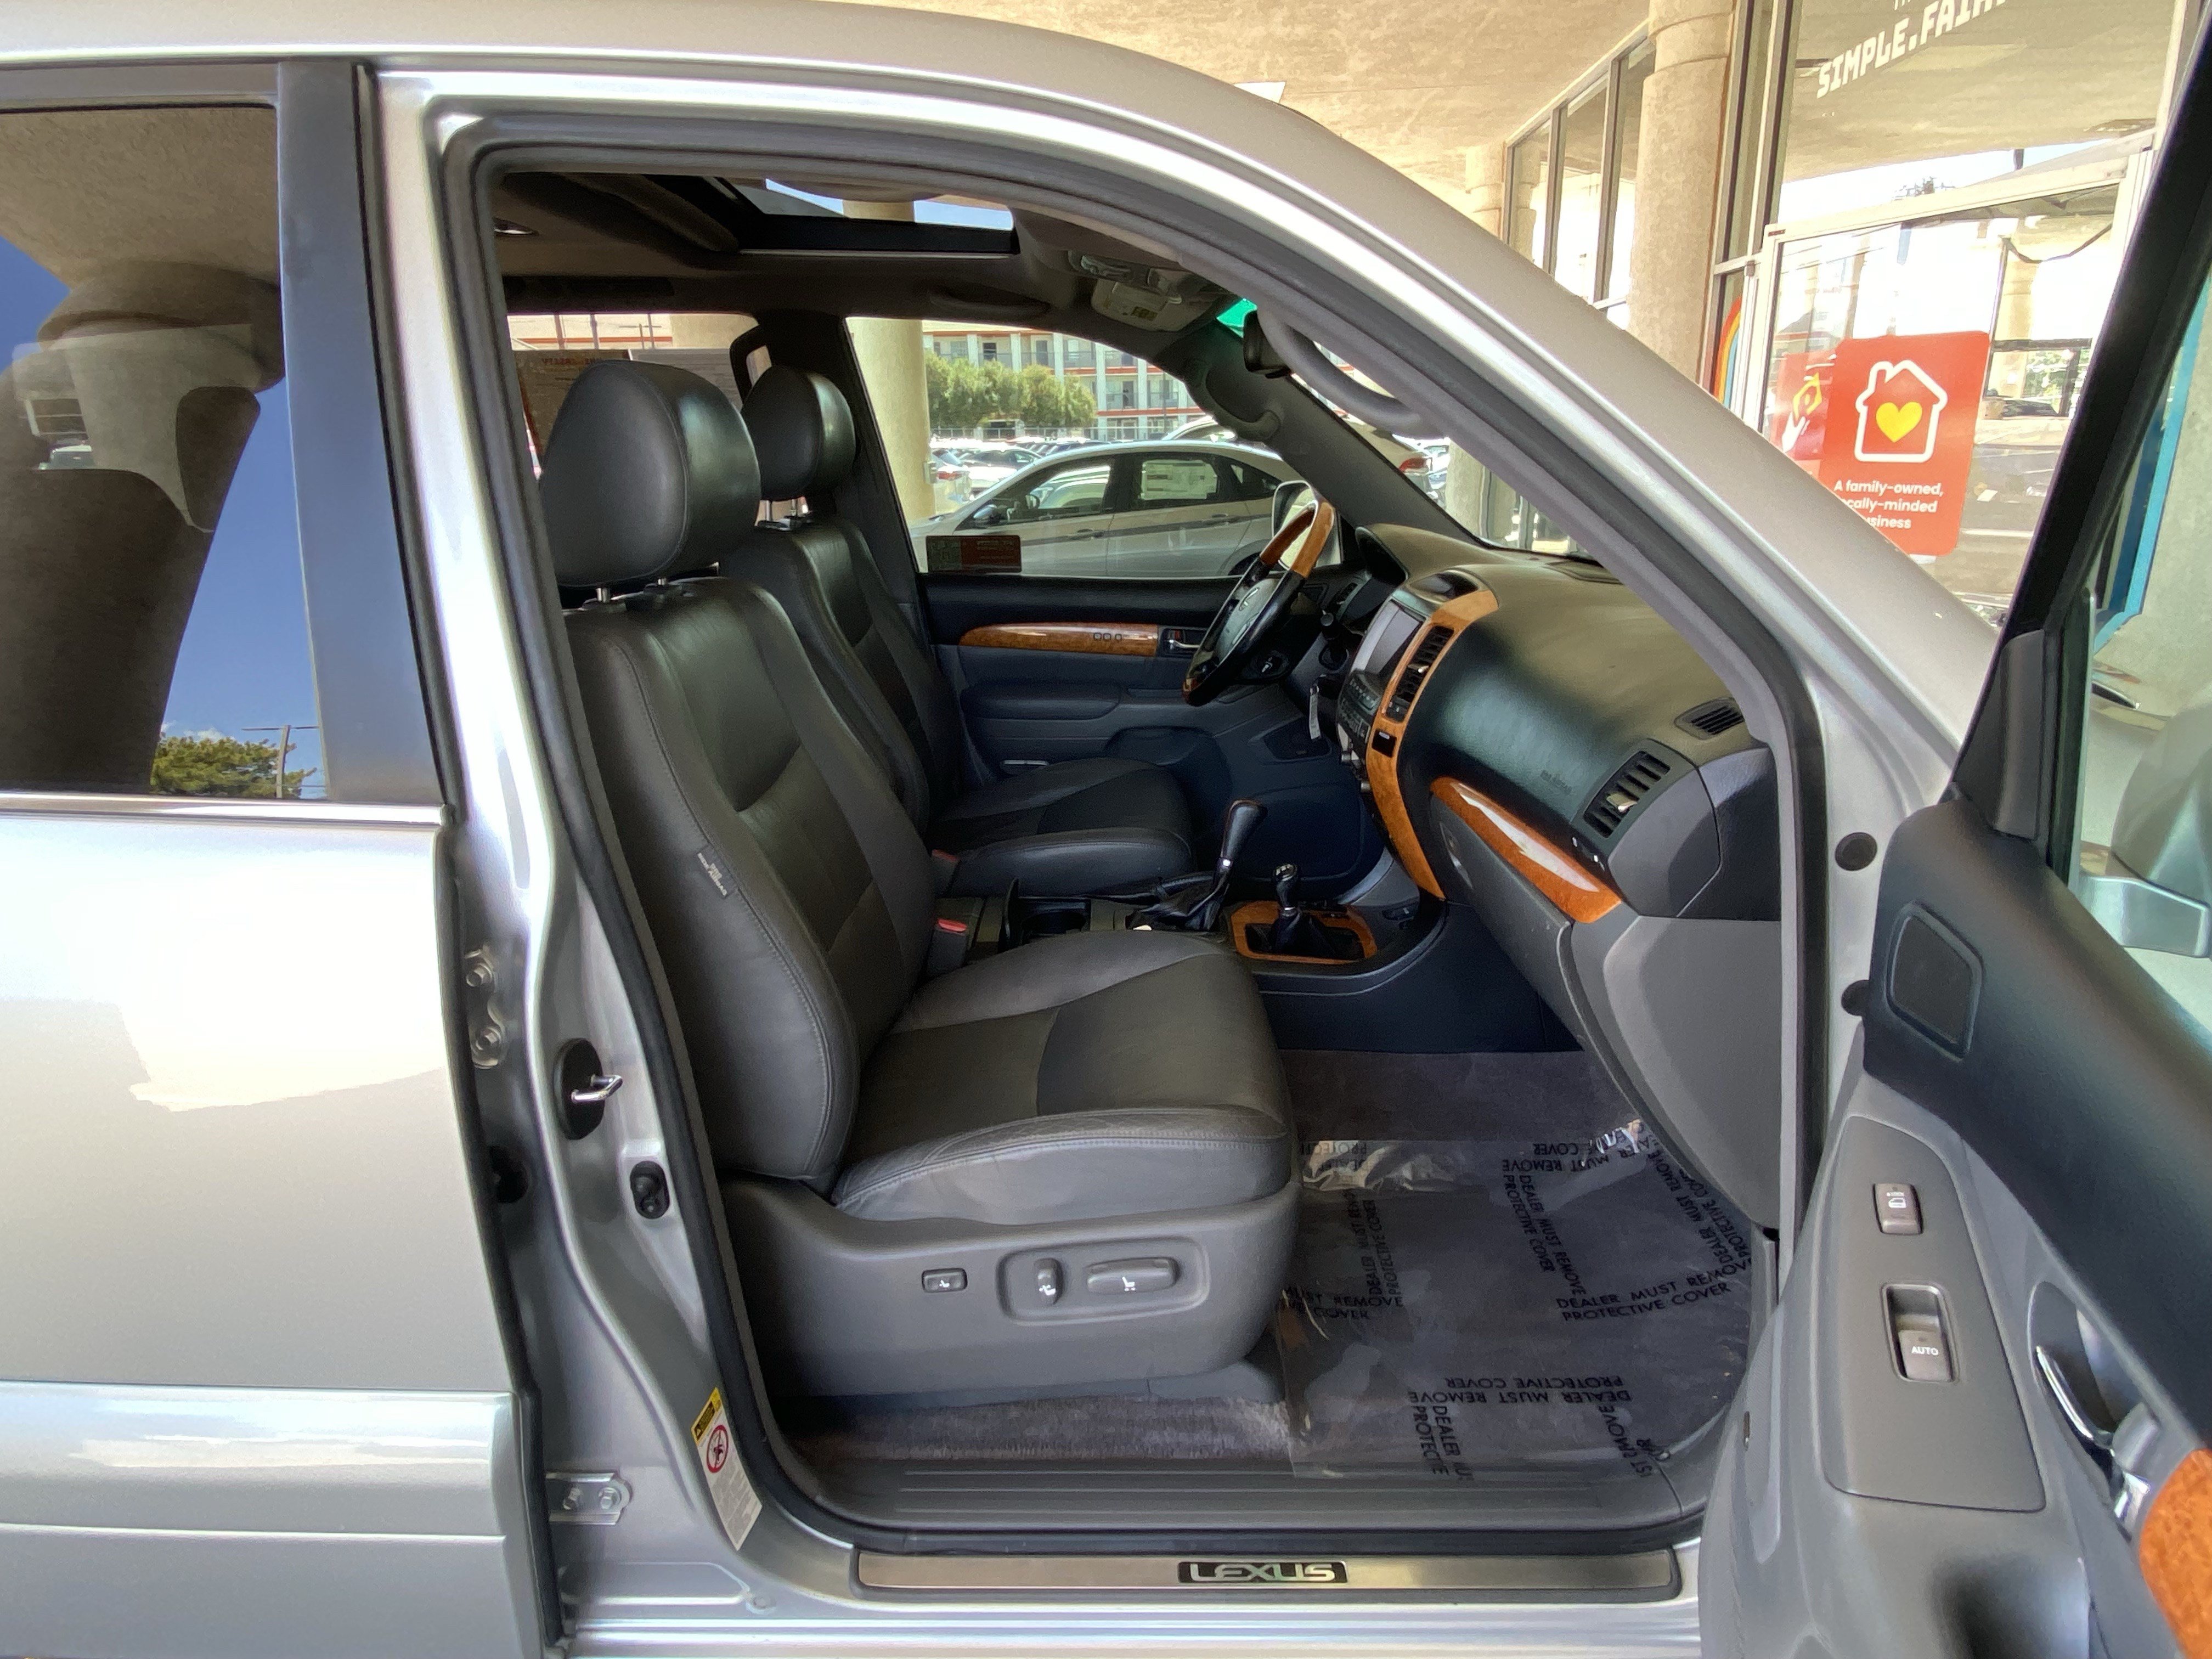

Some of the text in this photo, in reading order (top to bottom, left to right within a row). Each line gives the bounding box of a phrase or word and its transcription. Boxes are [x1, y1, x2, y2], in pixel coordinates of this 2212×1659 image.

[1834, 479, 1943, 496] A family-owned,
[1842, 497, 1938, 513] cally-minded
[1866, 515, 1911, 529] siness
[1532, 1142, 1579, 1156] COVER
[1502, 1159, 1563, 1172] REMOVE
[1647, 1149, 1681, 1193] REMOVE
[1503, 1175, 1555, 1272] PROTECTIVE COVER
[1702, 1199, 1751, 1258] PROTECTIVE
[1519, 1175, 1587, 1295] DEALER MUST REMOVE
[1699, 1226, 1734, 1263] DEALER
[1334, 1296, 1403, 1307] REMOVE
[1555, 1294, 1620, 1309] DEALER
[1630, 1281, 1677, 1302] MUST
[1562, 1282, 1732, 1321] PROTECTIVE COVER
[1911, 1345, 1939, 1356] AUTO
[1444, 1375, 1625, 1389] PROTECTIVE COVER
[1407, 1390, 1634, 1404] DEALER MUST REMOVE
[1432, 1406, 1461, 1456] DEALER
[1190, 1563, 1335, 1582] LEXUS
